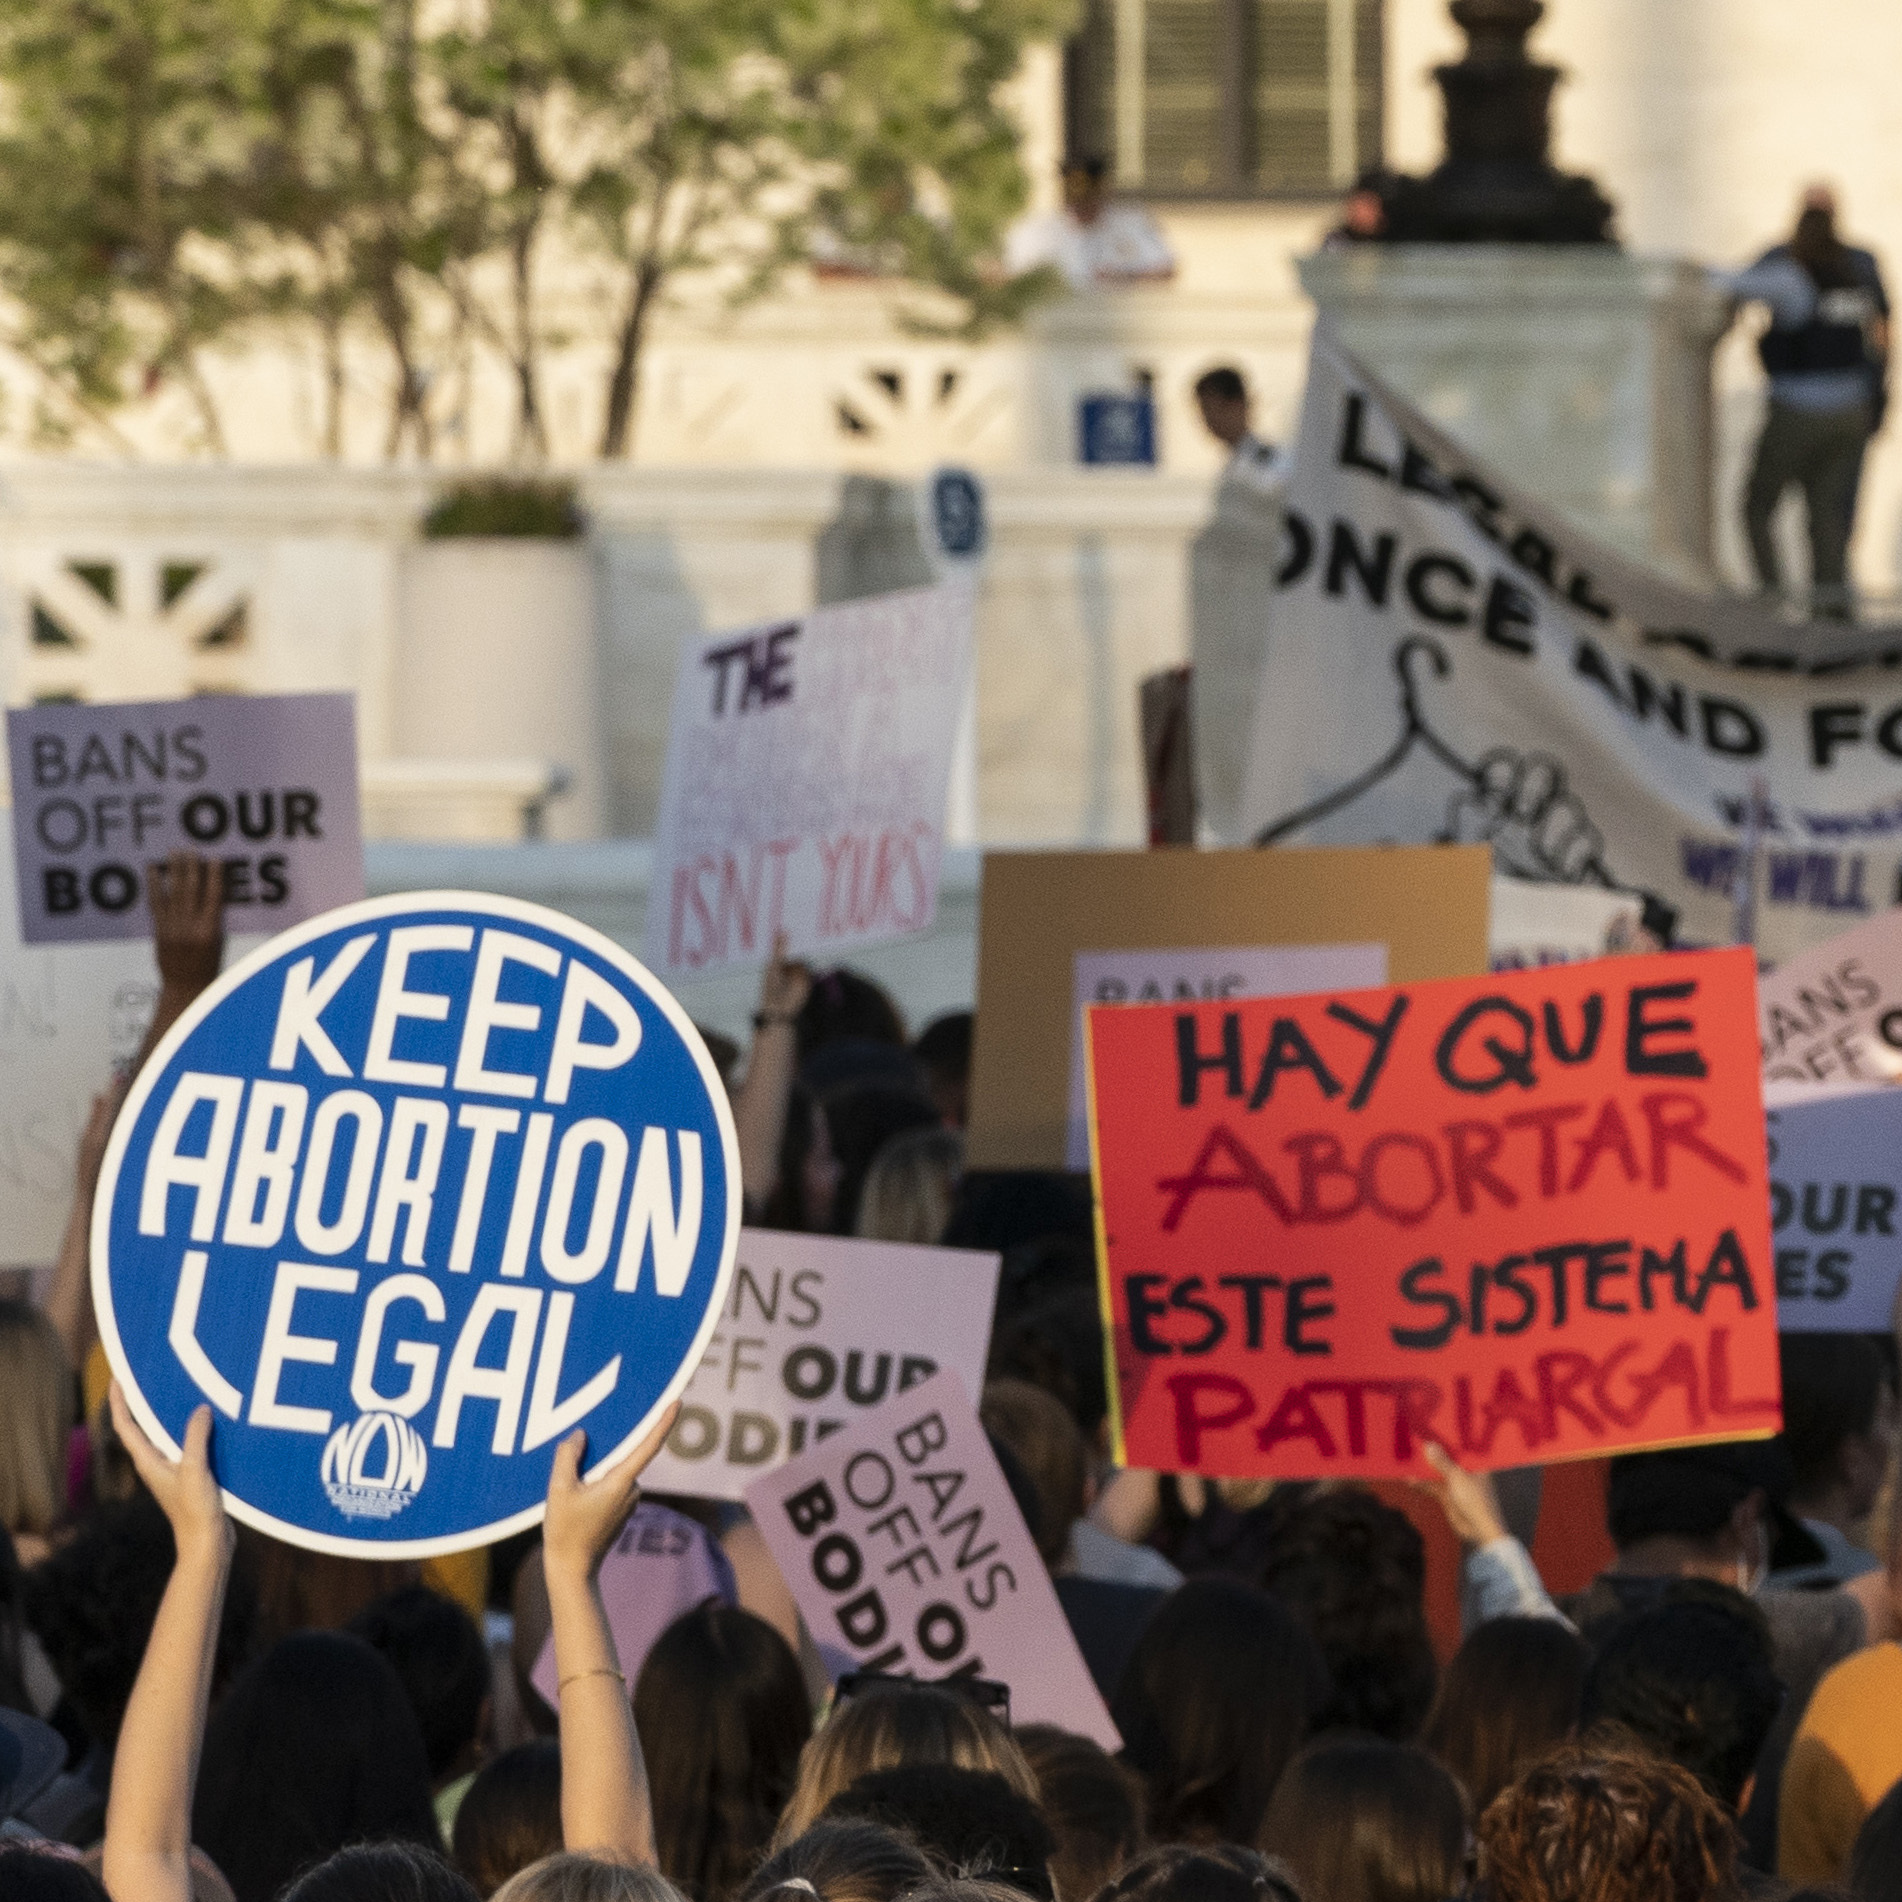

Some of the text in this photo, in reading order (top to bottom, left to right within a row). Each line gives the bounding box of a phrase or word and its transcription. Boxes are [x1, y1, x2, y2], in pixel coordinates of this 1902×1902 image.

[704, 620, 802, 719] THE
[31, 725, 207, 788] BANS
[37, 787, 322, 853] OFF OUR
[42, 855, 289, 916] BOES
[269, 924, 643, 1104] KEEP
[1175, 981, 1709, 1113] HAY QUE
[1762, 957, 1880, 1055] ANS
[138, 1071, 703, 1298] ABORTION
[1157, 1090, 1748, 1234] ABORTAR
[167, 1250, 623, 1456] LEGAL
[1124, 1271, 1338, 1357] ESTE
[1388, 1227, 1759, 1350] SISTEMA
[321, 1411, 428, 1493] NOW
[897, 1412, 1017, 1613] BANS
[844, 1449, 941, 1592] OFF
